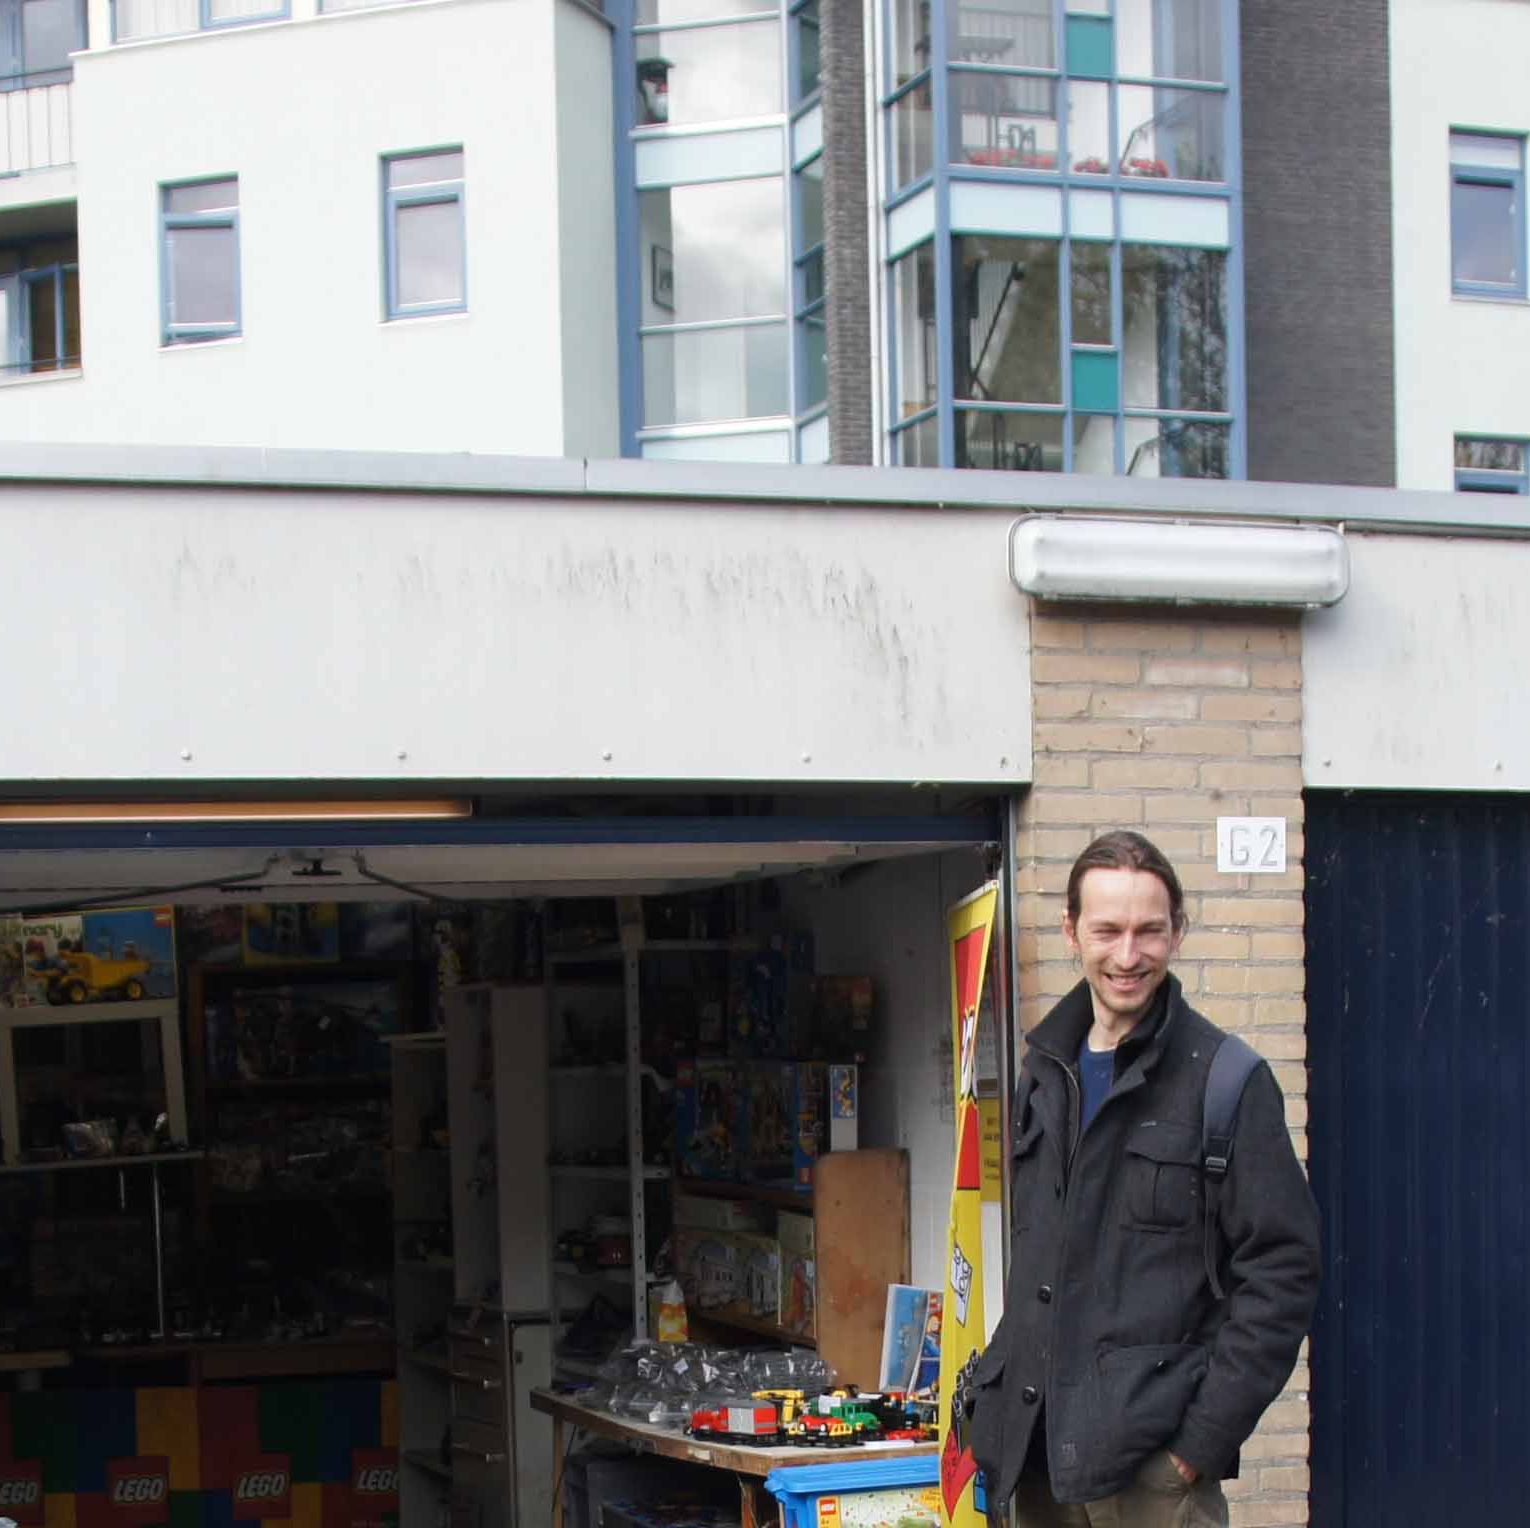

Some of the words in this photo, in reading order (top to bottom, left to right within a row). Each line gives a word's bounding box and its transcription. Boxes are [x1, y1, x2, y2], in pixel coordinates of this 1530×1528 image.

[1230, 825, 1277, 866] G2
[113, 1477, 166, 1503] LEGO
[237, 1472, 286, 1499] LEGO
